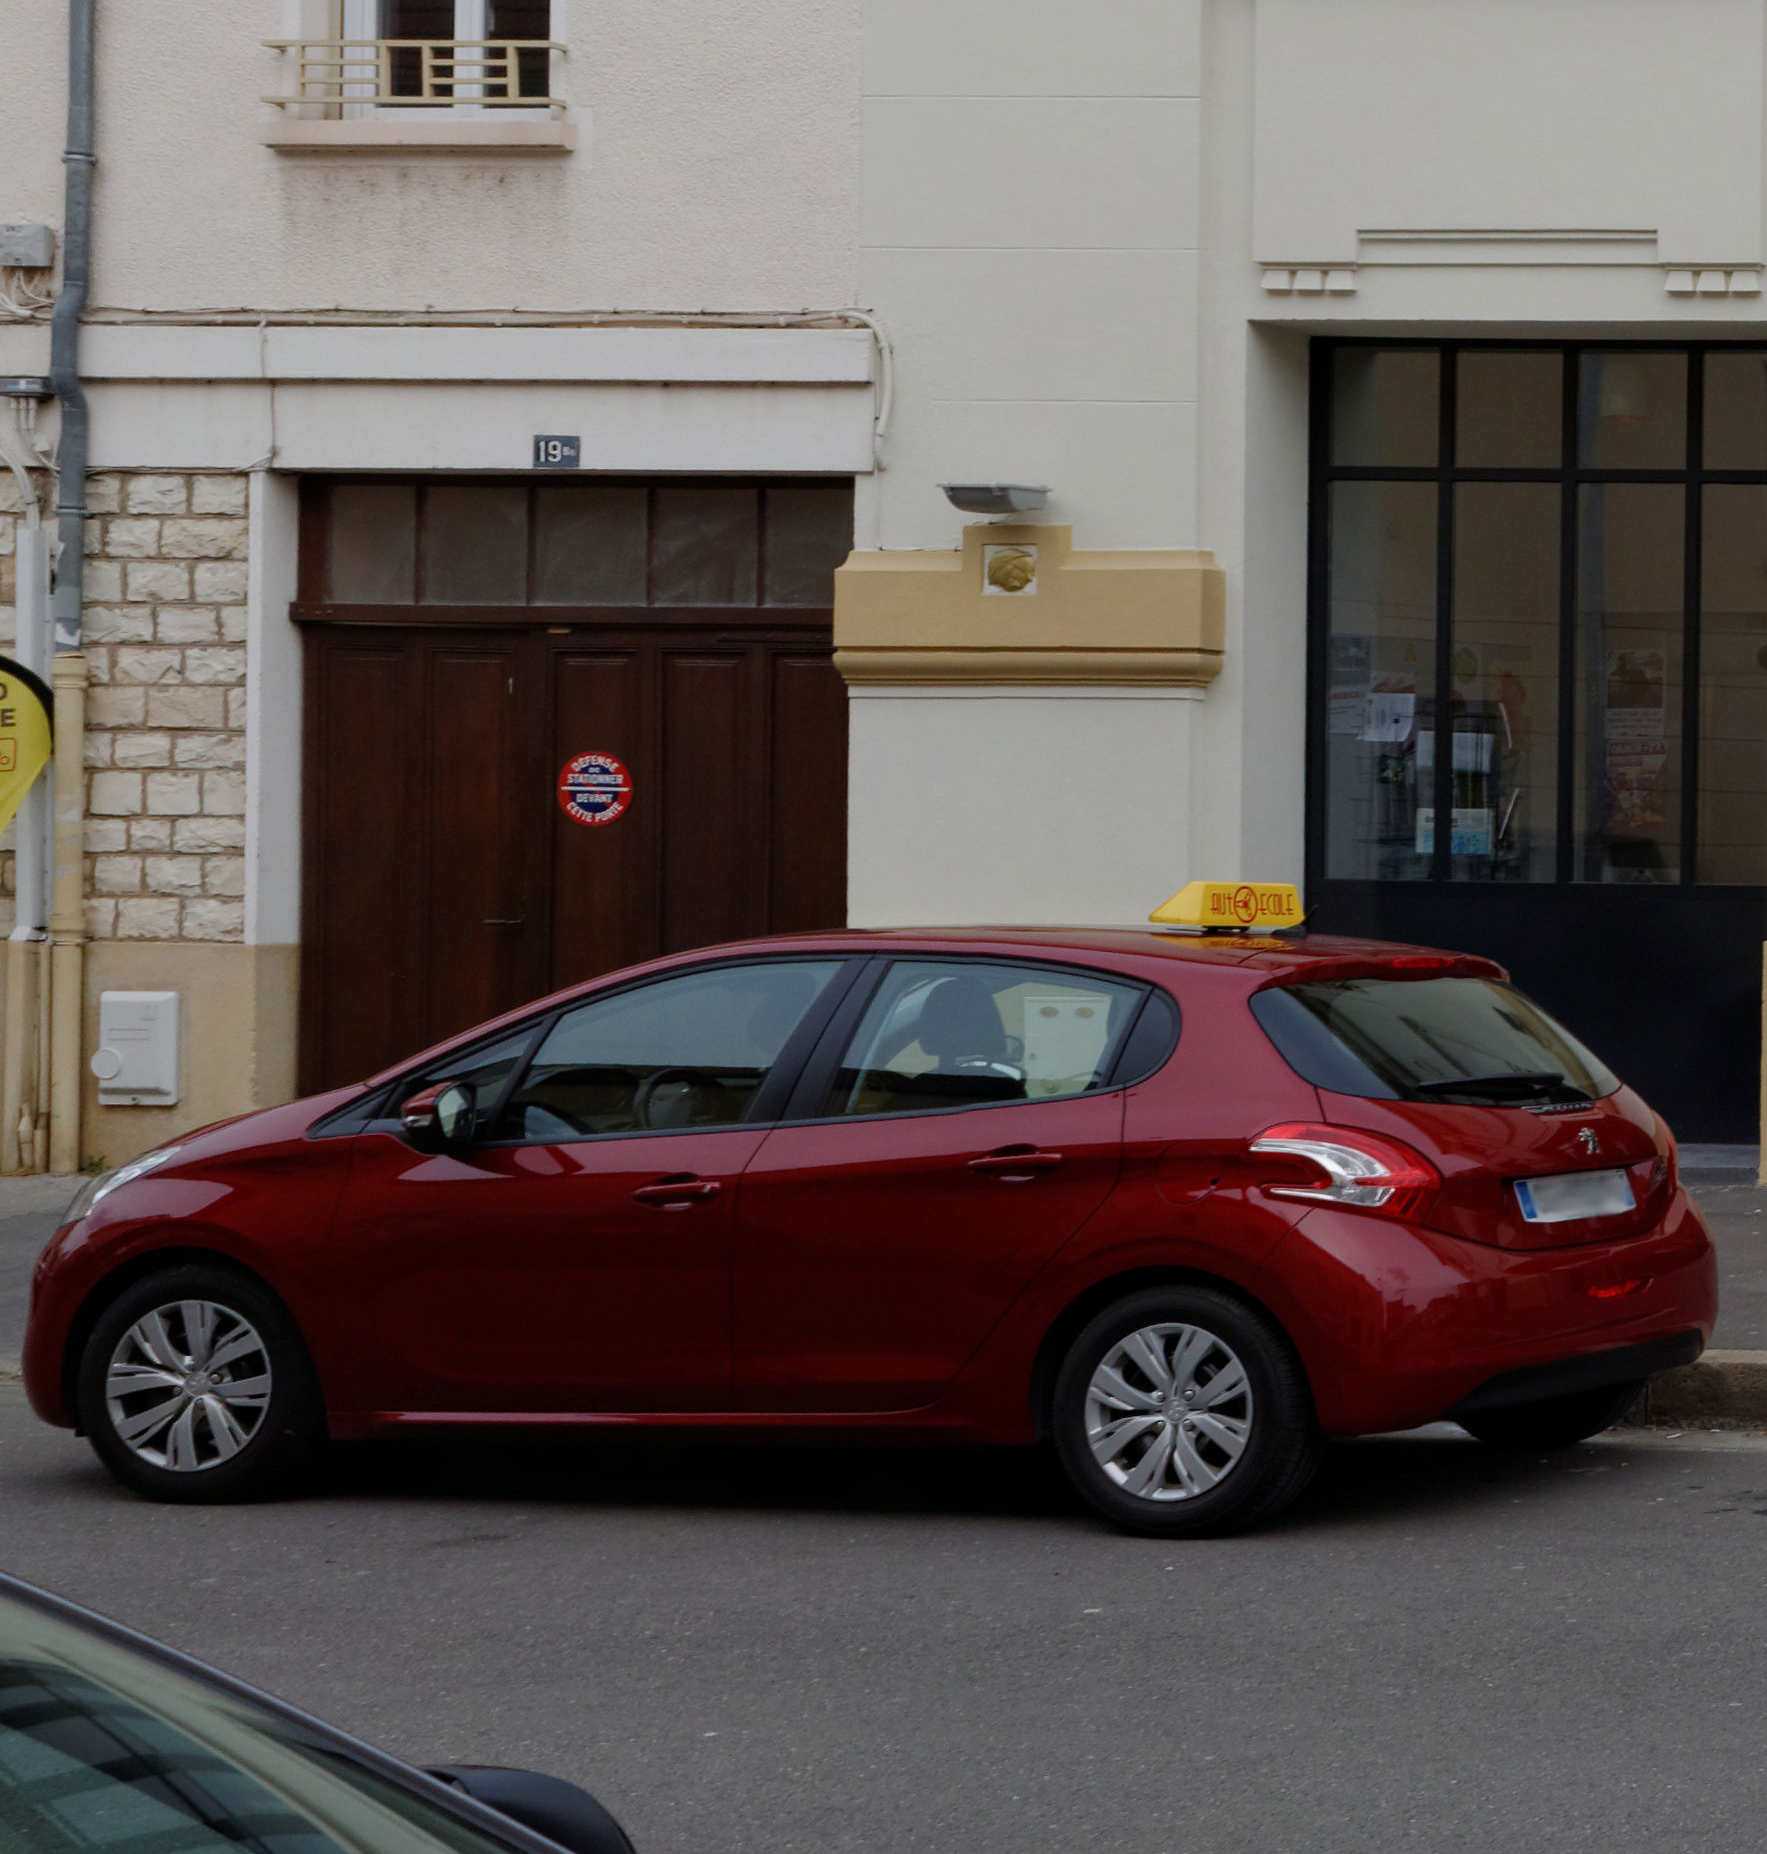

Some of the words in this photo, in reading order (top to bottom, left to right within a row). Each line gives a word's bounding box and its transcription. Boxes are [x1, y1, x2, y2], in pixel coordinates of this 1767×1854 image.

[538, 440, 562, 462] 19
[567, 774, 624, 785] STATIONNER
[576, 793, 614, 803] DEVANT
[566, 802, 593, 822] CETTE
[594, 802, 624, 822] PORTE
